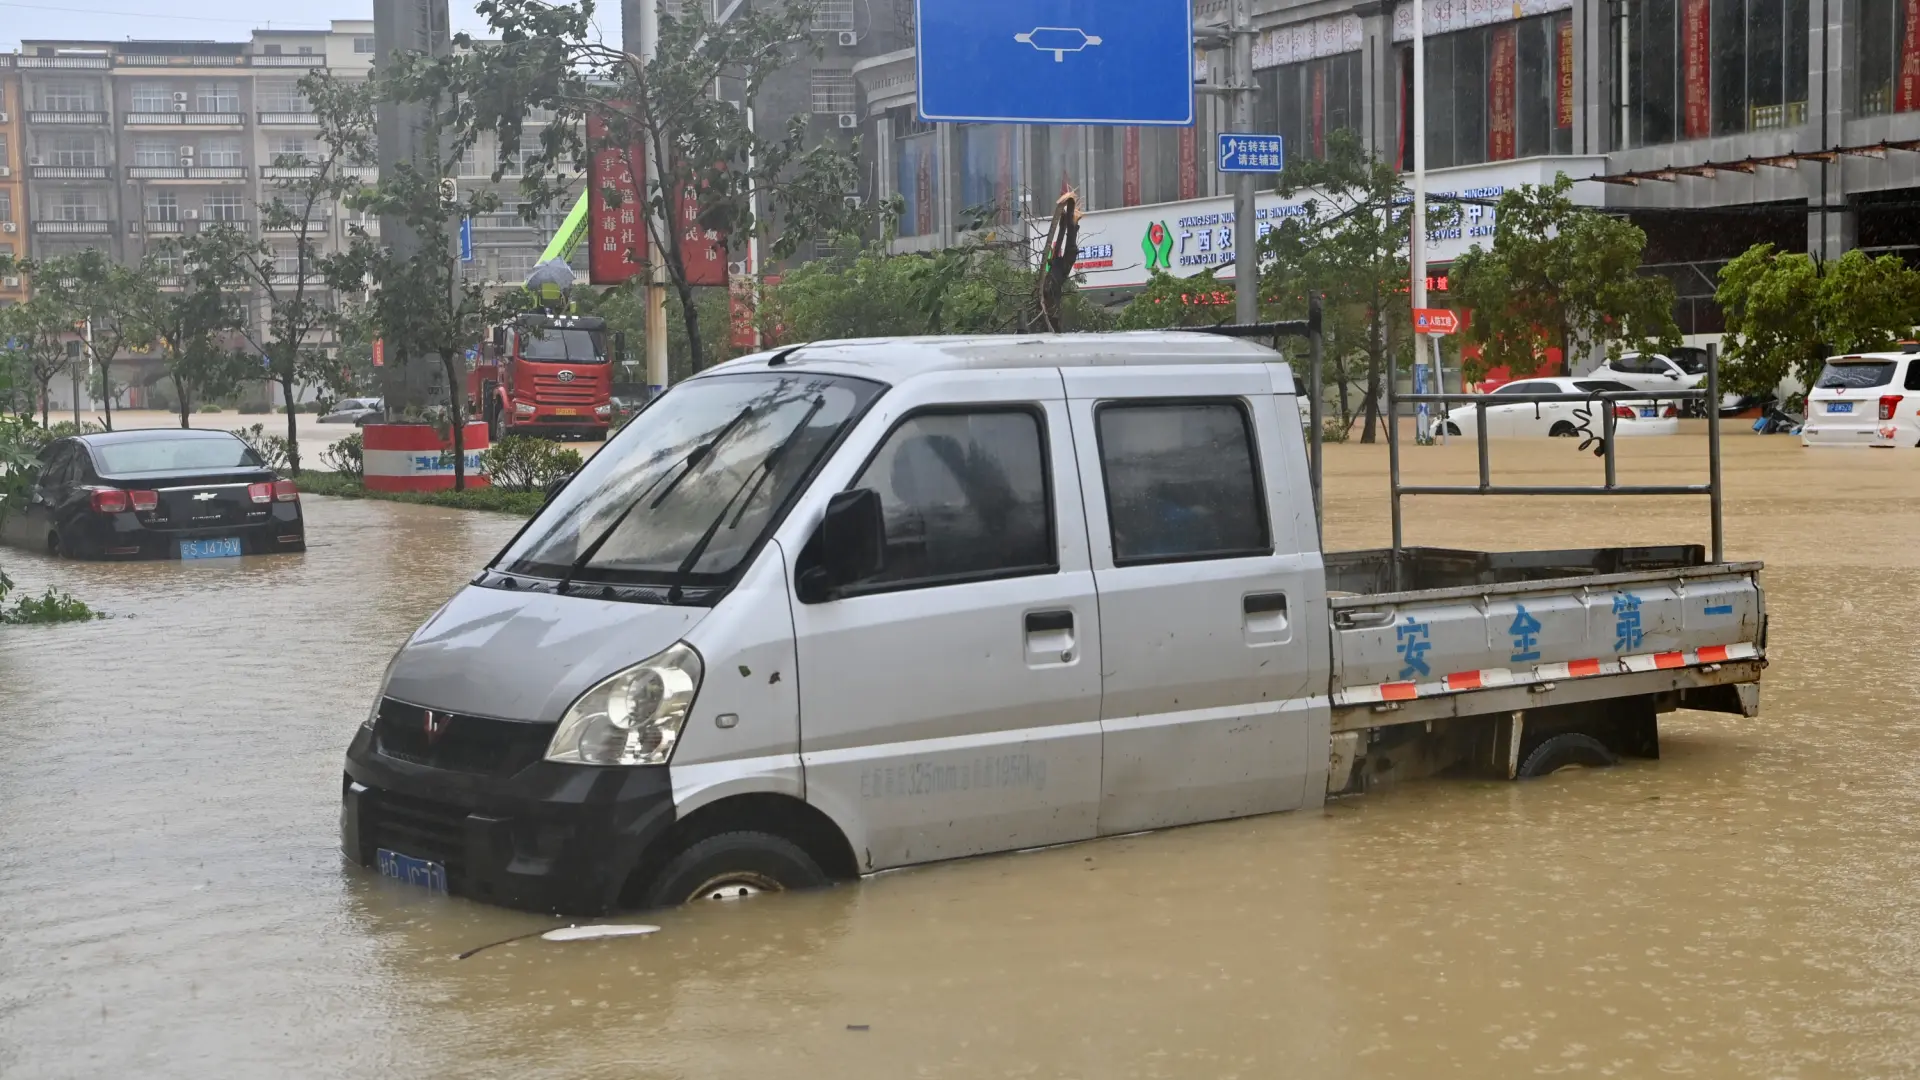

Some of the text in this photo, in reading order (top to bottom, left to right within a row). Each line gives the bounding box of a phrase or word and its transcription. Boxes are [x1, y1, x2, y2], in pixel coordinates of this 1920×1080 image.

[1238, 140, 1279, 152] 右转车辆
[1238, 153, 1279, 166] 请走辅道
[1180, 252, 1236, 266] GUANGXI RUR
[1396, 592, 1732, 678] 安全第一
